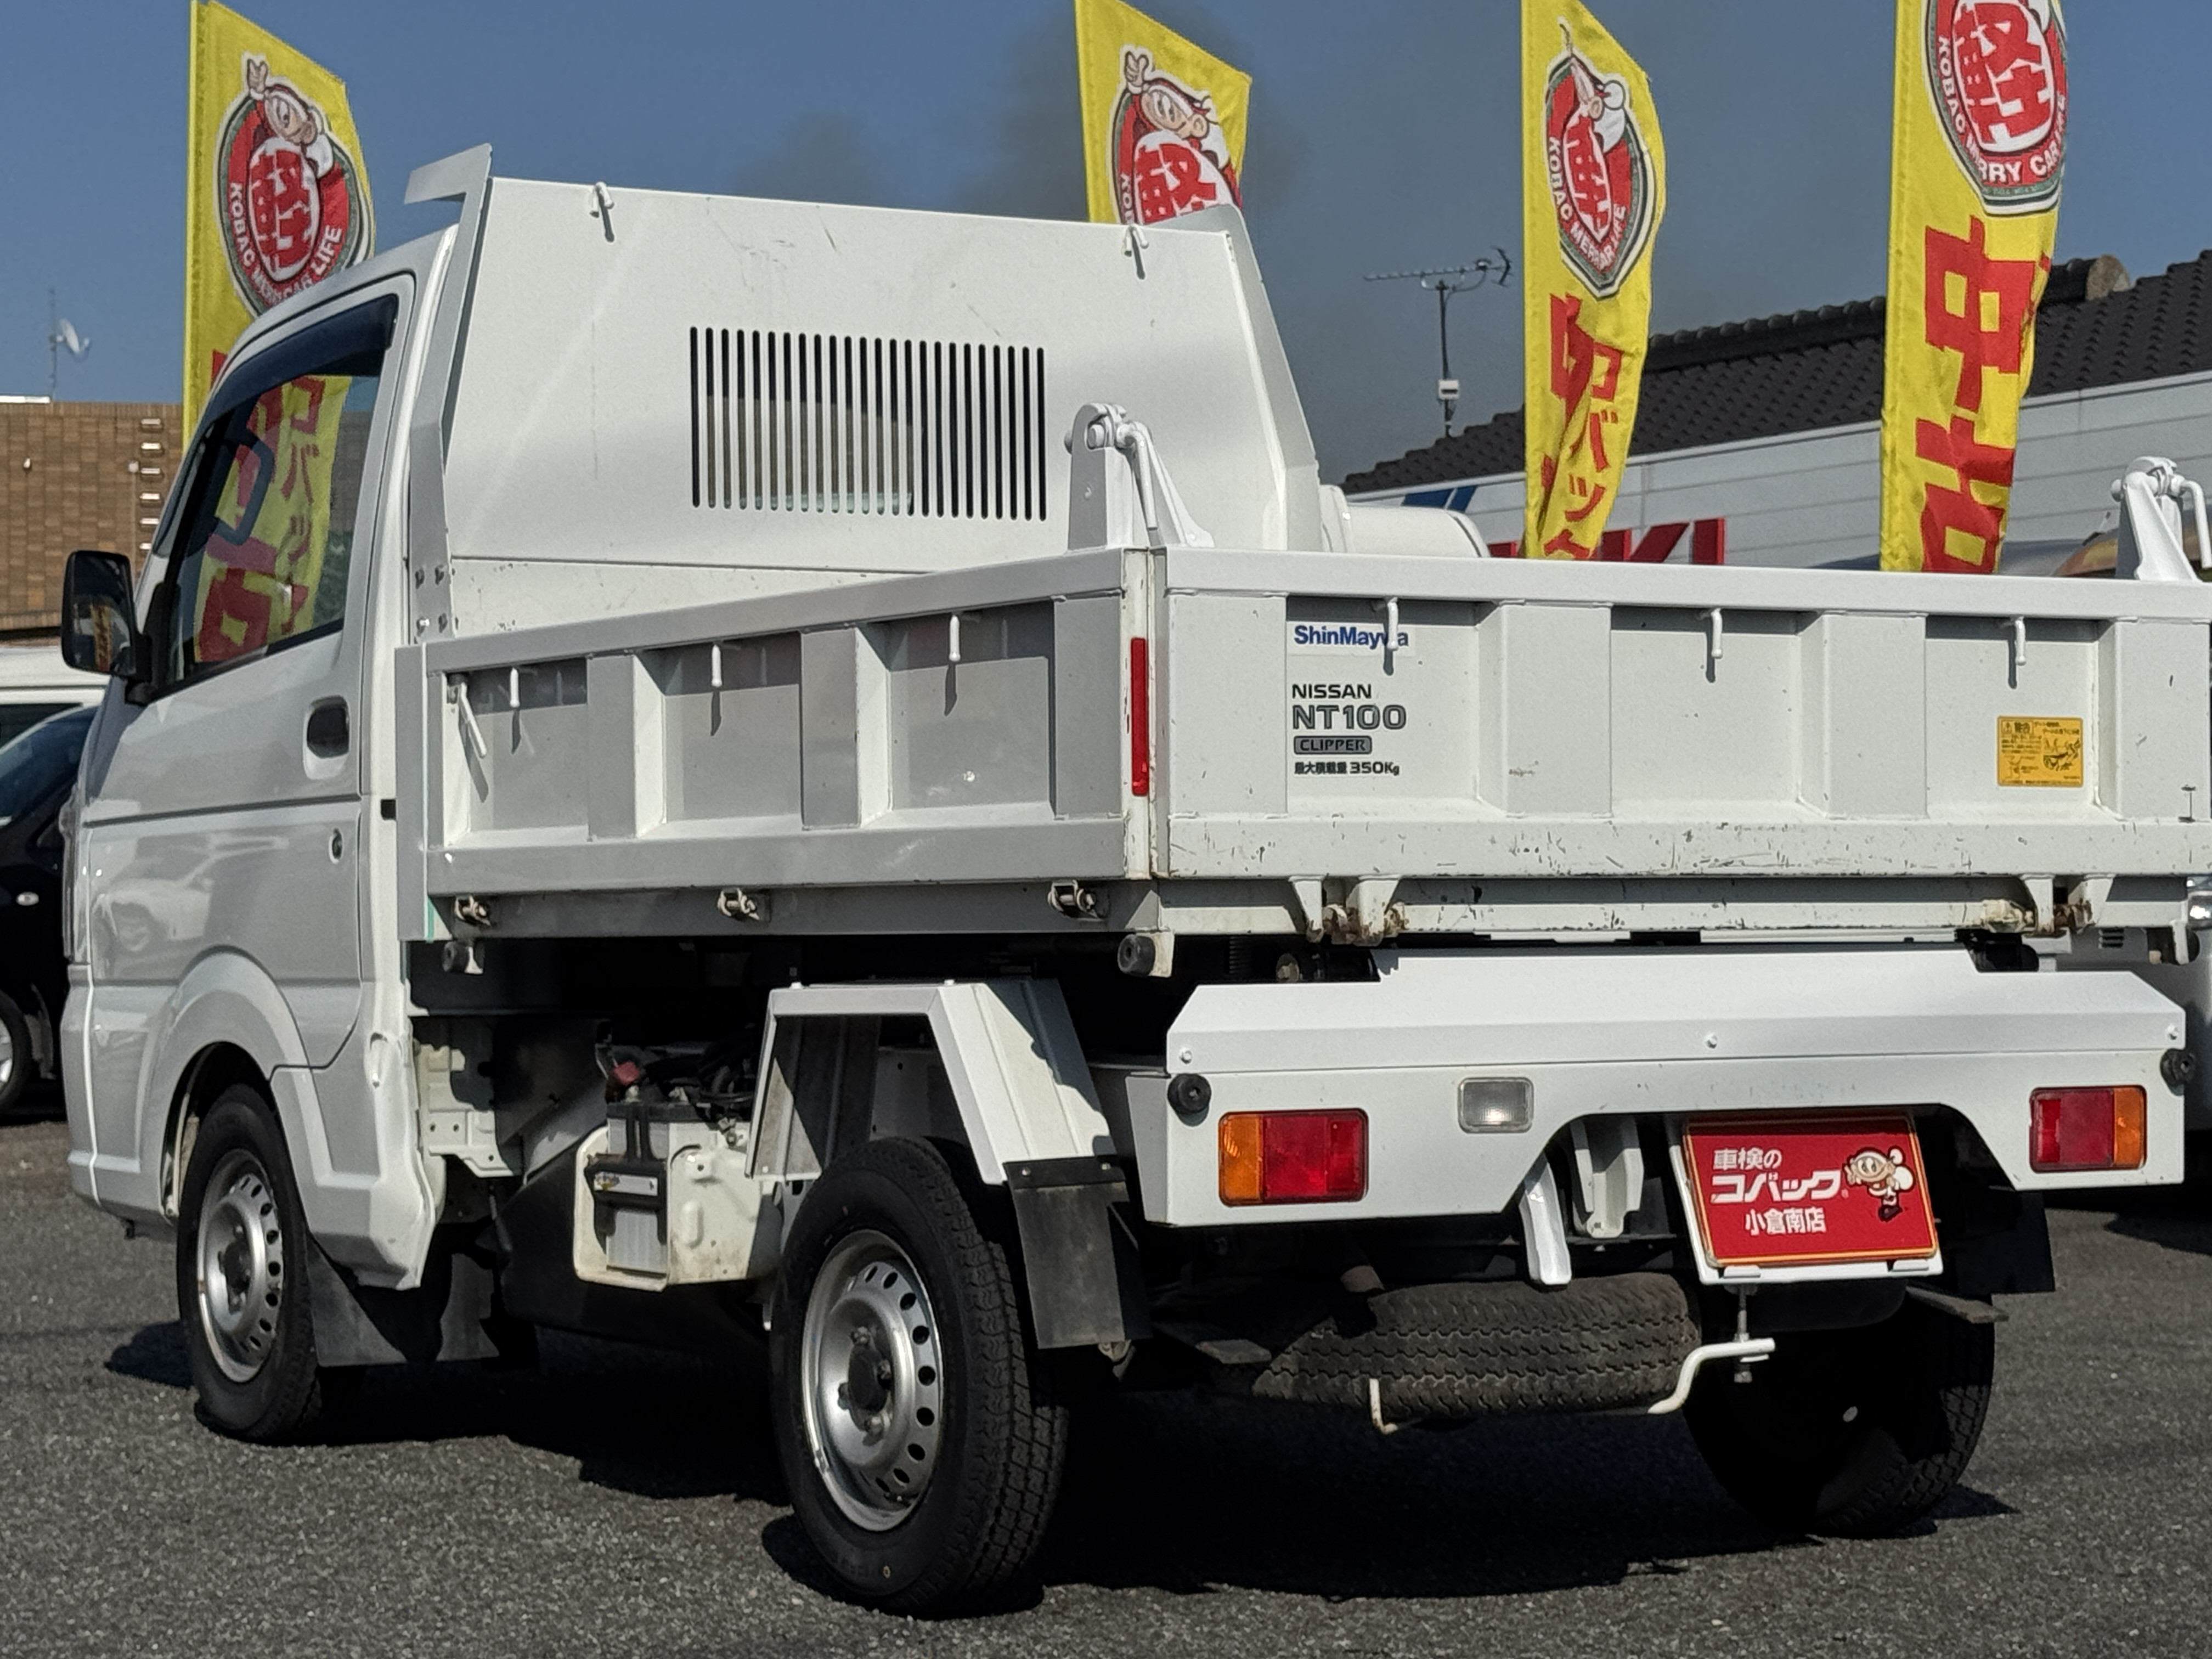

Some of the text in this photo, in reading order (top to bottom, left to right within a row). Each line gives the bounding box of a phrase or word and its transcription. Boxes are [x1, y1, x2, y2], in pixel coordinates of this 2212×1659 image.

[229, 182, 256, 268] KOBAC
[310, 225, 342, 276] LIFE
[1294, 625, 1409, 650] ShinMaya
[1292, 684, 1372, 698] NISSAN
[1293, 704, 1407, 730] NT100
[1300, 739, 1366, 751] CLIPPER
[1712, 1148, 1782, 1171] 車検の
[1710, 1169, 1842, 1204] コバック
[1745, 1207, 1827, 1236] 小倉南店
